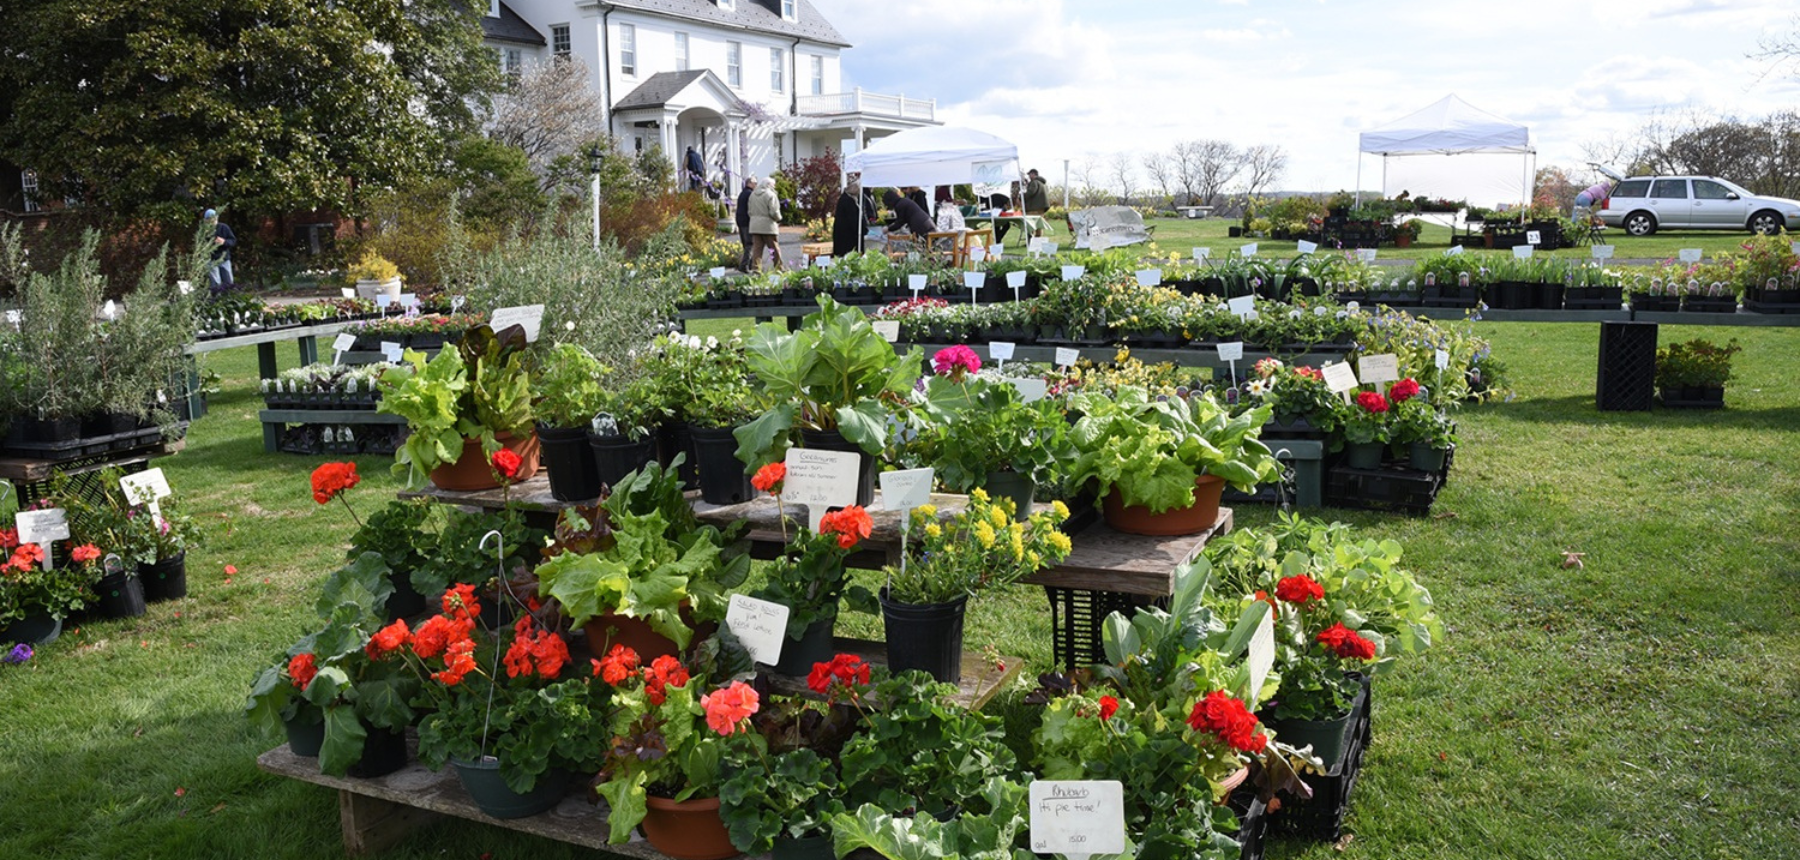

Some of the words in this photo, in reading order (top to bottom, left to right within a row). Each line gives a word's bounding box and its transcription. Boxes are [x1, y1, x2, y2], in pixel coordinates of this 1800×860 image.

[1051, 784, 1090, 797] Rhubarb
[1055, 803, 1070, 817] pie
[1074, 800, 1101, 813] time!
